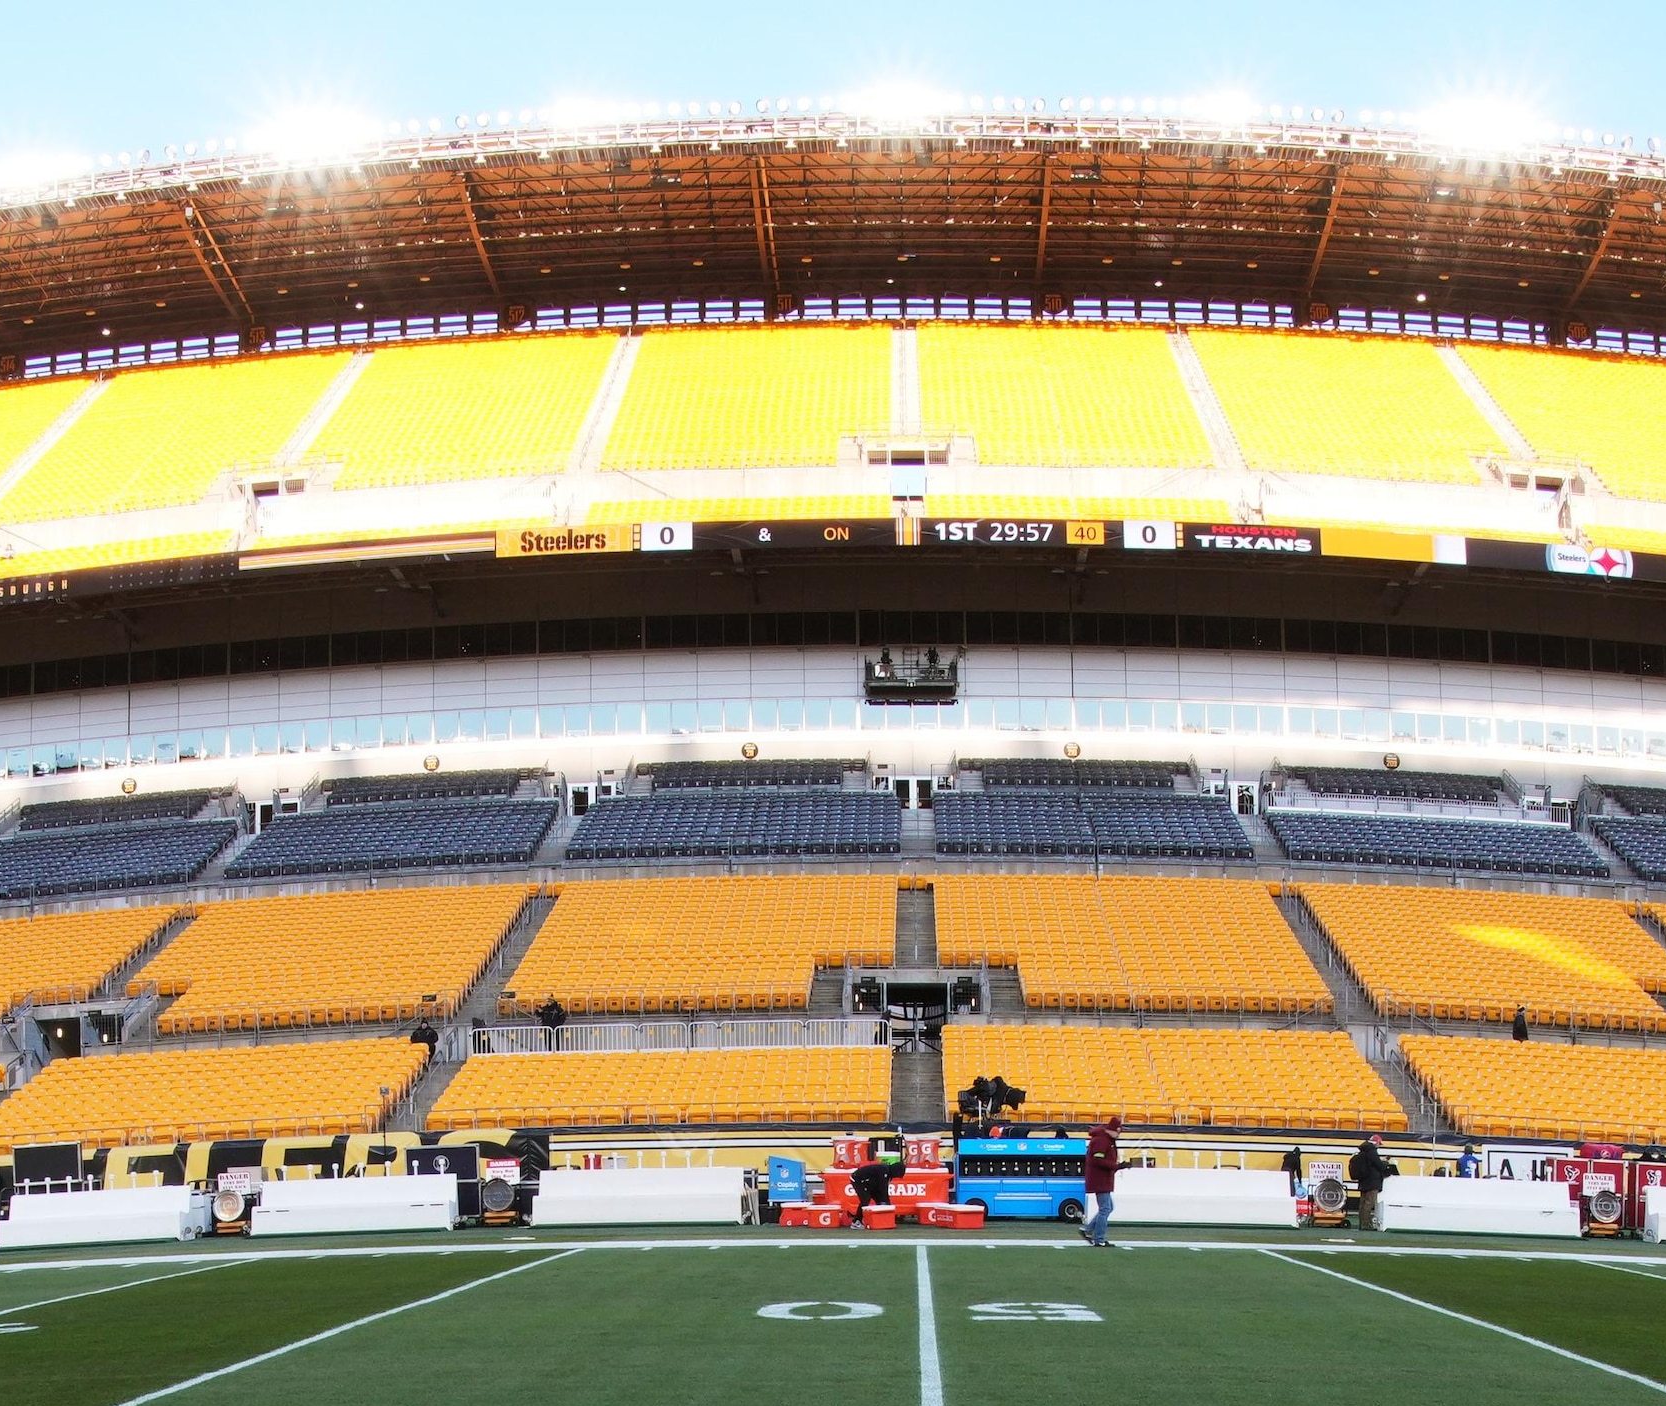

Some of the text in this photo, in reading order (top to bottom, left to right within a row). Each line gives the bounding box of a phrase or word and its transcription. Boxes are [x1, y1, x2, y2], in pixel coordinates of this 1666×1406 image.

[777, 297, 792, 310] 511
[1045, 298, 1062, 311] 510
[509, 309, 524, 323] 512
[660, 527, 674, 545] 0
[758, 526, 849, 542] & ON
[934, 522, 1053, 543] 1ST 29:57
[1074, 527, 1096, 541] 40
[1142, 525, 1156, 544] 0
[1211, 525, 1297, 537] HOUSTON
[520, 528, 606, 553] Steelers
[1195, 535, 1312, 552] TEXANS
[1557, 552, 1586, 563] Steelers
[836, 1144, 846, 1155] G
[908, 1144, 918, 1155] G
[921, 1144, 931, 1155] G
[219, 1173, 249, 1181] DANGER
[1584, 1174, 1614, 1182] DANGER
[844, 1184, 926, 1197] GRADE
[819, 1212, 831, 1226] G
